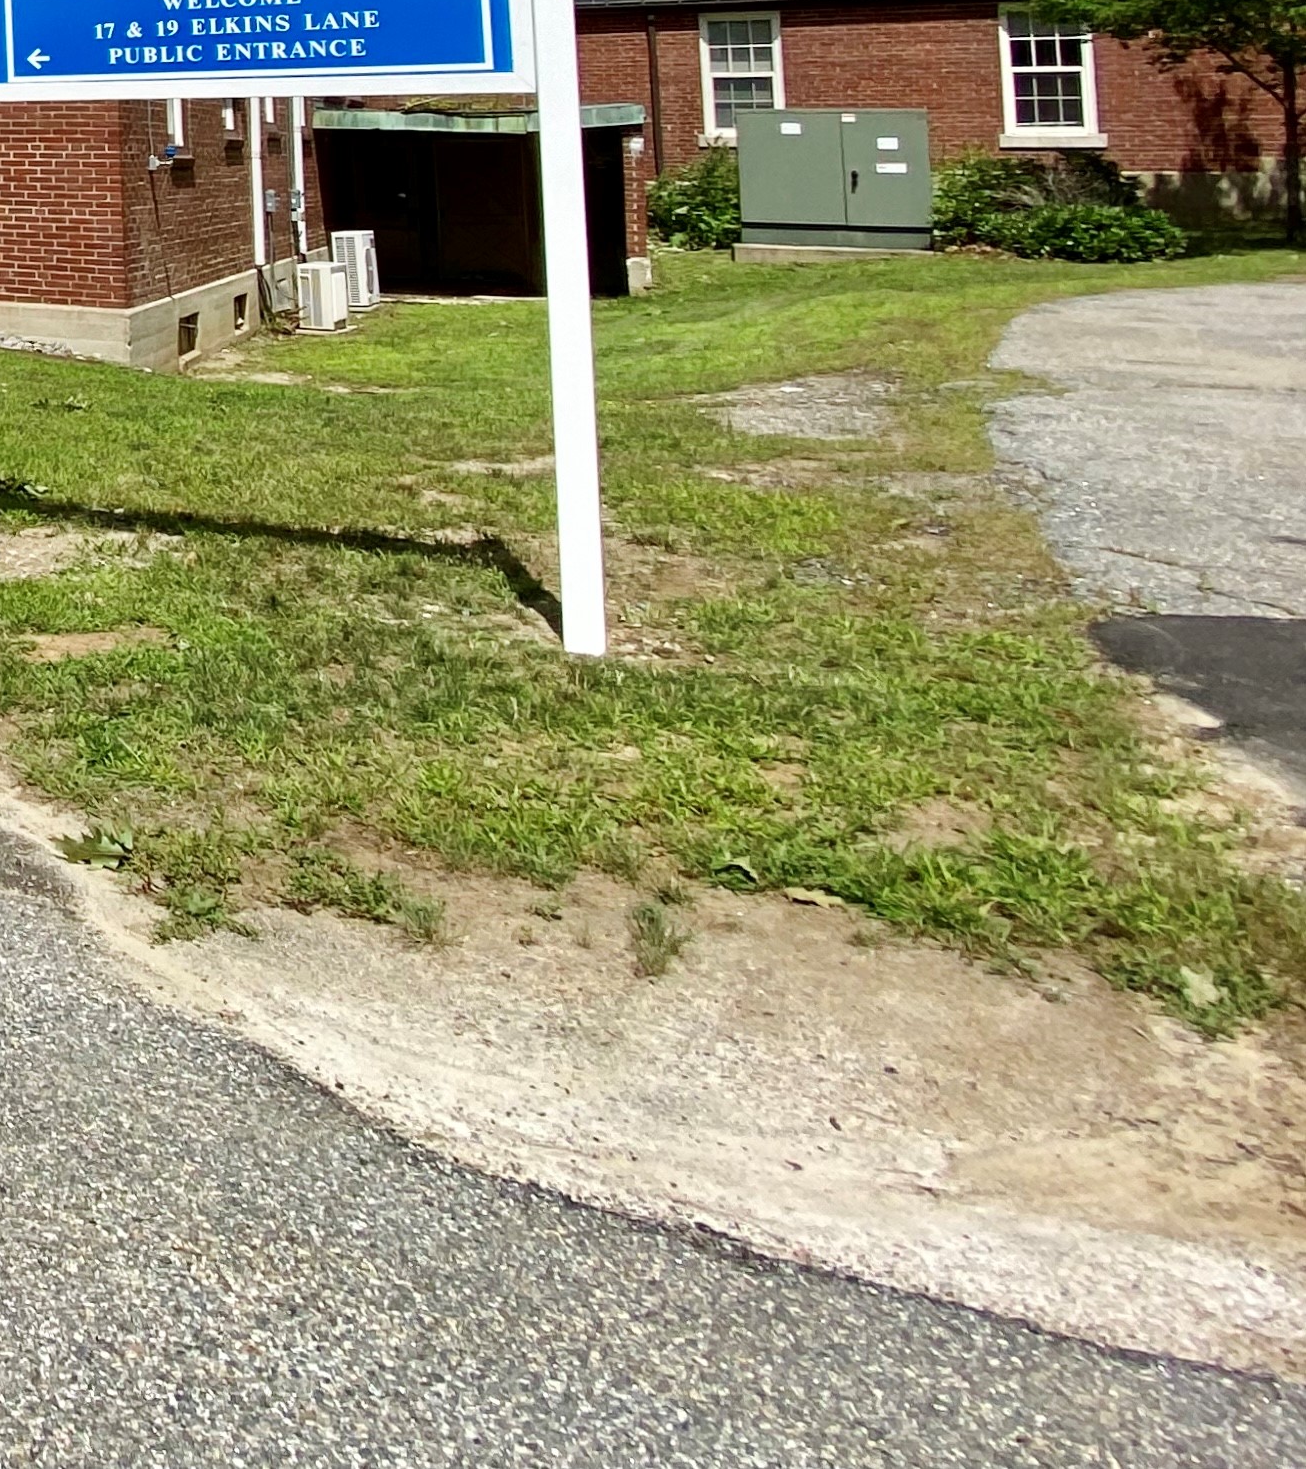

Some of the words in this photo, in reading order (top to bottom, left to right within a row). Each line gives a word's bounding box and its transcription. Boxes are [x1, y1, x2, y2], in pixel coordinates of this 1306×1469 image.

[94, 22, 115, 39] 17
[126, 21, 143, 38] &
[156, 19, 179, 37] 19
[191, 14, 290, 36] ELKINS
[304, 10, 379, 30] LANE
[108, 44, 203, 64] PUBLIC
[216, 38, 367, 61] ENTRANCE
